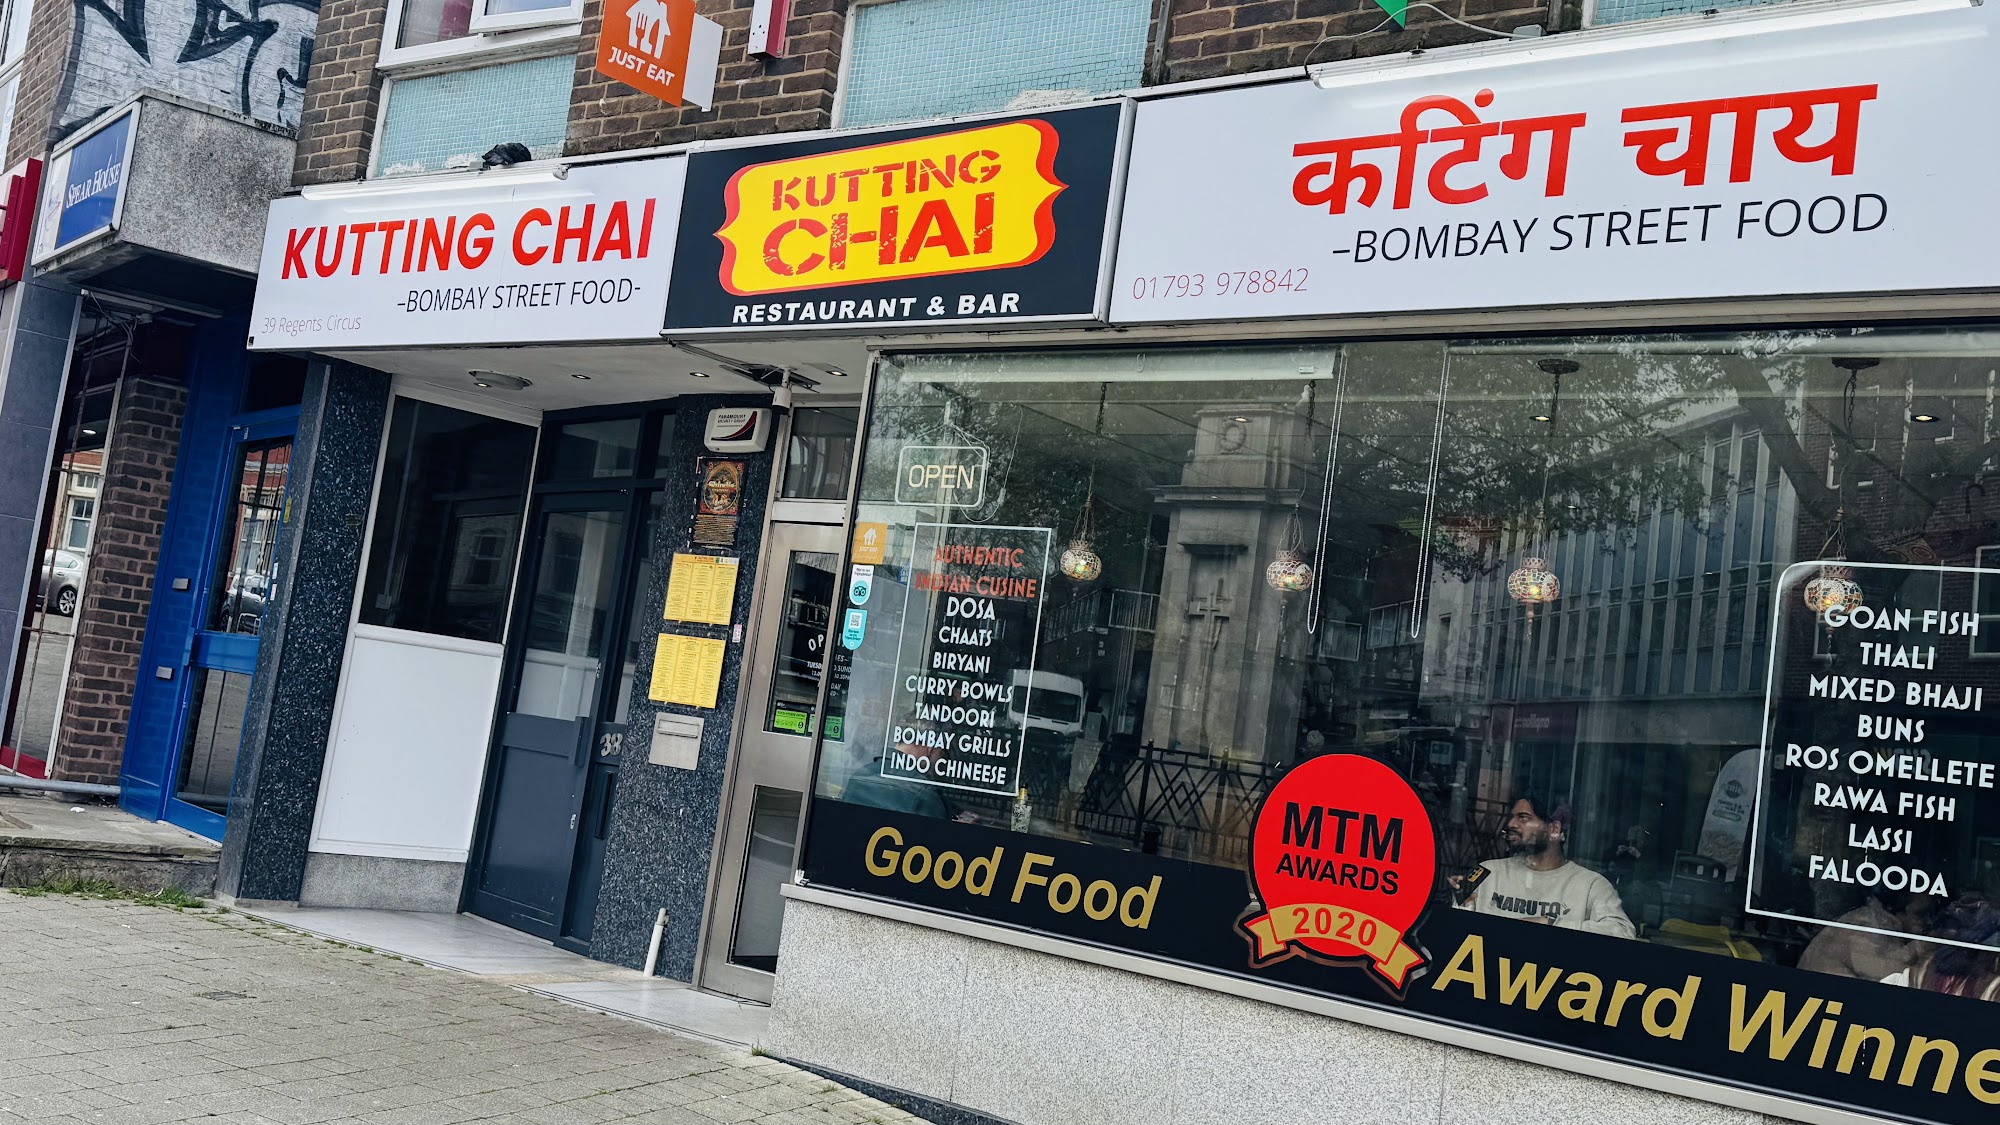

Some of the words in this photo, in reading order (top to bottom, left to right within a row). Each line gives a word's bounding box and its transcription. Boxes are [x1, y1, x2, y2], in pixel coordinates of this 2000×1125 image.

[608, 46, 646, 73] JUST
[646, 63, 675, 86] EAT
[1292, 88, 1587, 216] कटिंग
[1621, 83, 1878, 187] चाय
[66, 180, 92, 209] SPEAR
[91, 162, 120, 195] HOUSE
[772, 149, 1001, 212] KUTTING
[763, 191, 995, 277] CHAI
[1550, 205, 1722, 251] STREET
[1737, 193, 1888, 240] FOOD
[281, 212, 494, 280] KUTTING
[513, 197, 656, 267] CHAI
[493, 282, 566, 309] STREET
[1133, 272, 1205, 302] 01793
[1216, 266, 1310, 297] 978842
[732, 295, 918, 324] RESTAURANT
[926, 295, 945, 317] &
[957, 292, 1020, 316] BAR
[262, 316, 276, 334] 39
[279, 315, 323, 336] Regents
[326, 313, 362, 332] Circus
[908, 464, 976, 489] OPEN
[934, 545, 1025, 567] AUTHENTIC
[915, 570, 972, 594] INDIAN
[976, 575, 1037, 598] CUSINE
[946, 596, 996, 621] DOSA
[1824, 605, 1911, 632] GOAN
[1922, 609, 1980, 637] FISH
[938, 625, 993, 648] CHAATS
[933, 652, 991, 674] BIRYANI
[1860, 642, 1935, 671] THALI
[905, 675, 957, 697] CURRY
[960, 680, 1013, 703] BOWLS
[1808, 674, 1896, 704] MIXED
[1905, 681, 1983, 712] BHAJI
[915, 702, 995, 728] TANDOORI
[1857, 714, 1925, 743] BUNS
[599, 732, 623, 757] 38
[893, 726, 955, 750] BOMBAY
[958, 735, 1011, 758] GRILLS
[890, 753, 930, 776] INDO
[934, 758, 1007, 785] CHINEESE
[1785, 743, 1840, 771] ROS
[1848, 750, 1996, 788] OMELLETE
[1814, 783, 1888, 814] RAWA
[1898, 791, 1956, 822] FISH
[1282, 802, 1403, 864] MTM
[1848, 823, 1912, 854] LASSI
[864, 827, 1002, 897] Good
[1011, 846, 1162, 930] Food
[1275, 853, 1399, 896] AWARDS
[1808, 855, 1948, 897] FALOODA
[1491, 892, 1561, 918] NARUTO
[1293, 907, 1377, 947] 2020
[1432, 933, 1701, 1040] Award
